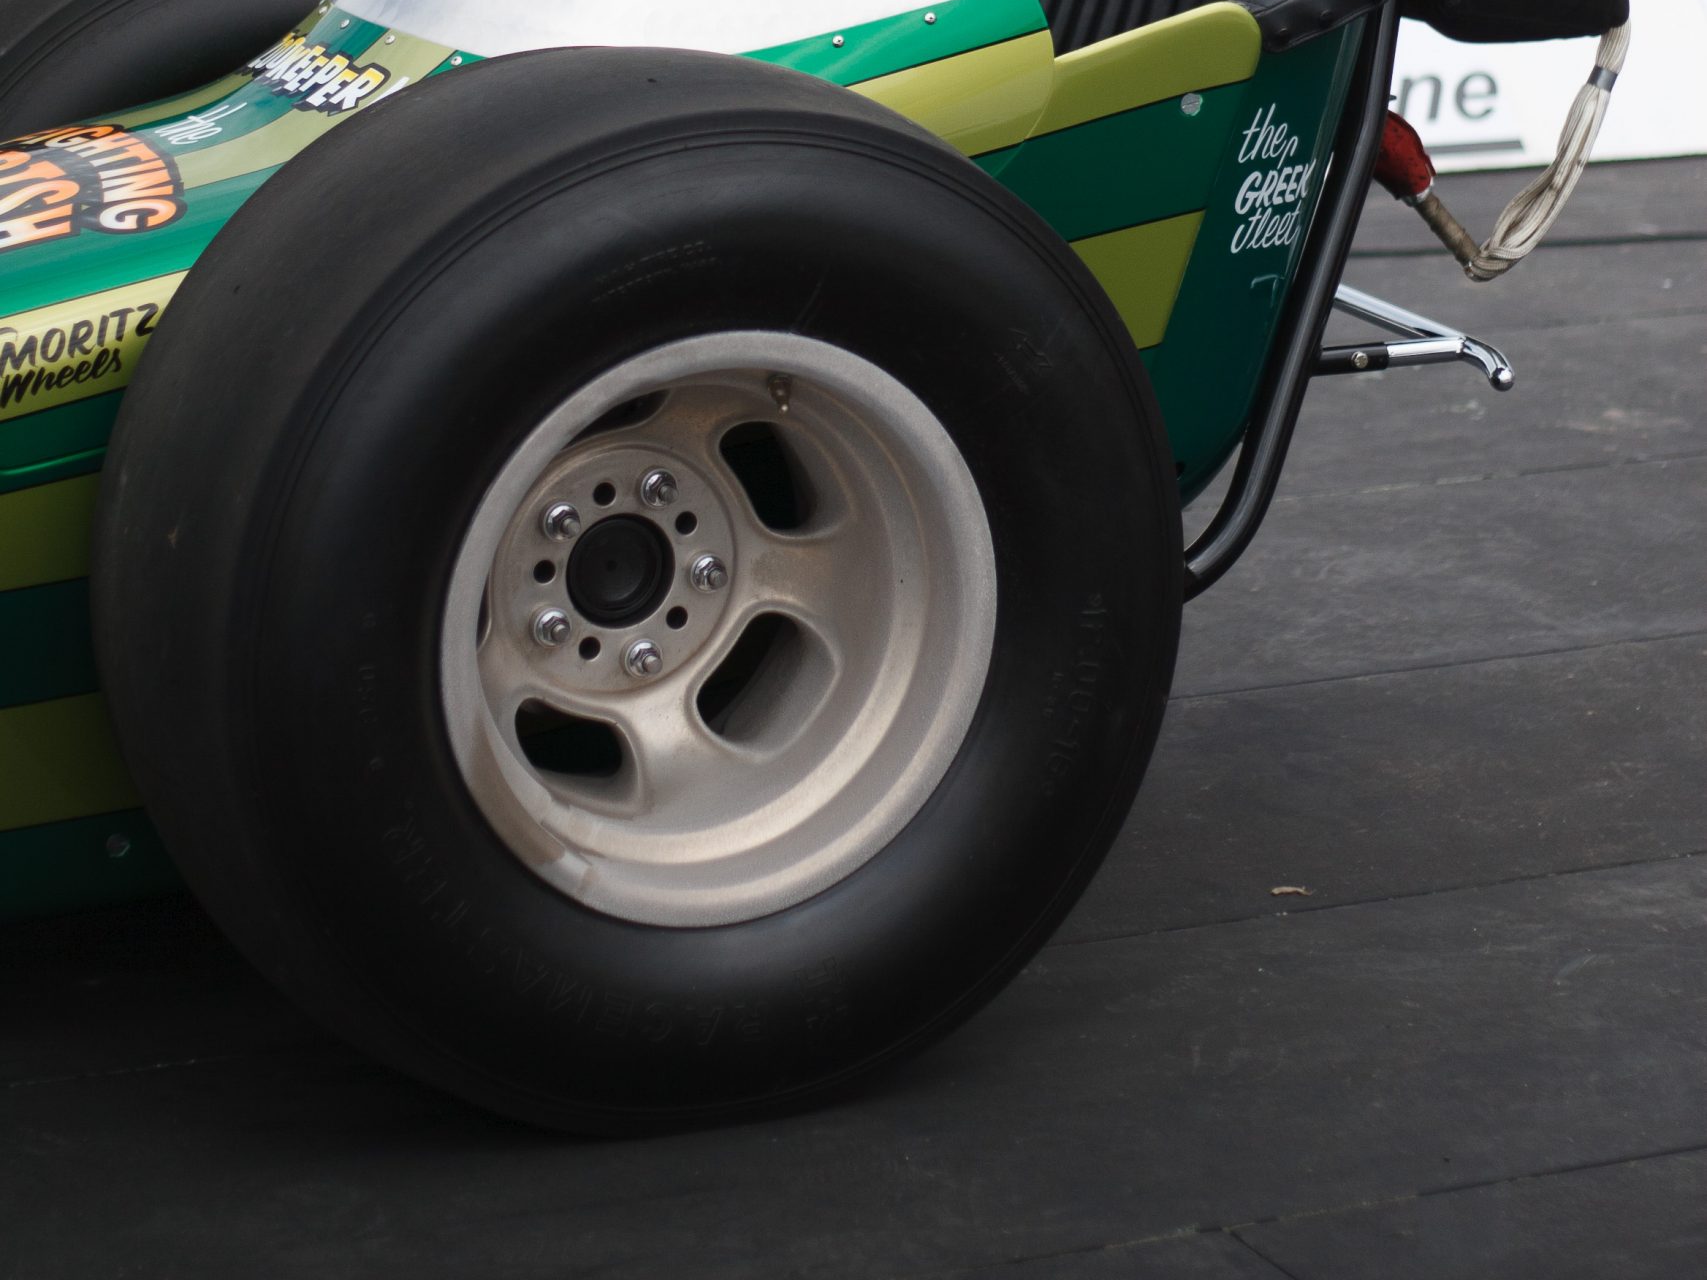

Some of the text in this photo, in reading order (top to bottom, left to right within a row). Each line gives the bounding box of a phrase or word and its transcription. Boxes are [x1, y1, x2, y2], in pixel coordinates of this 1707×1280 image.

[154, 101, 248, 145] the
[1237, 102, 1289, 164] the
[1234, 158, 1317, 215] GREEK
[0, 302, 160, 378] MORITZ
